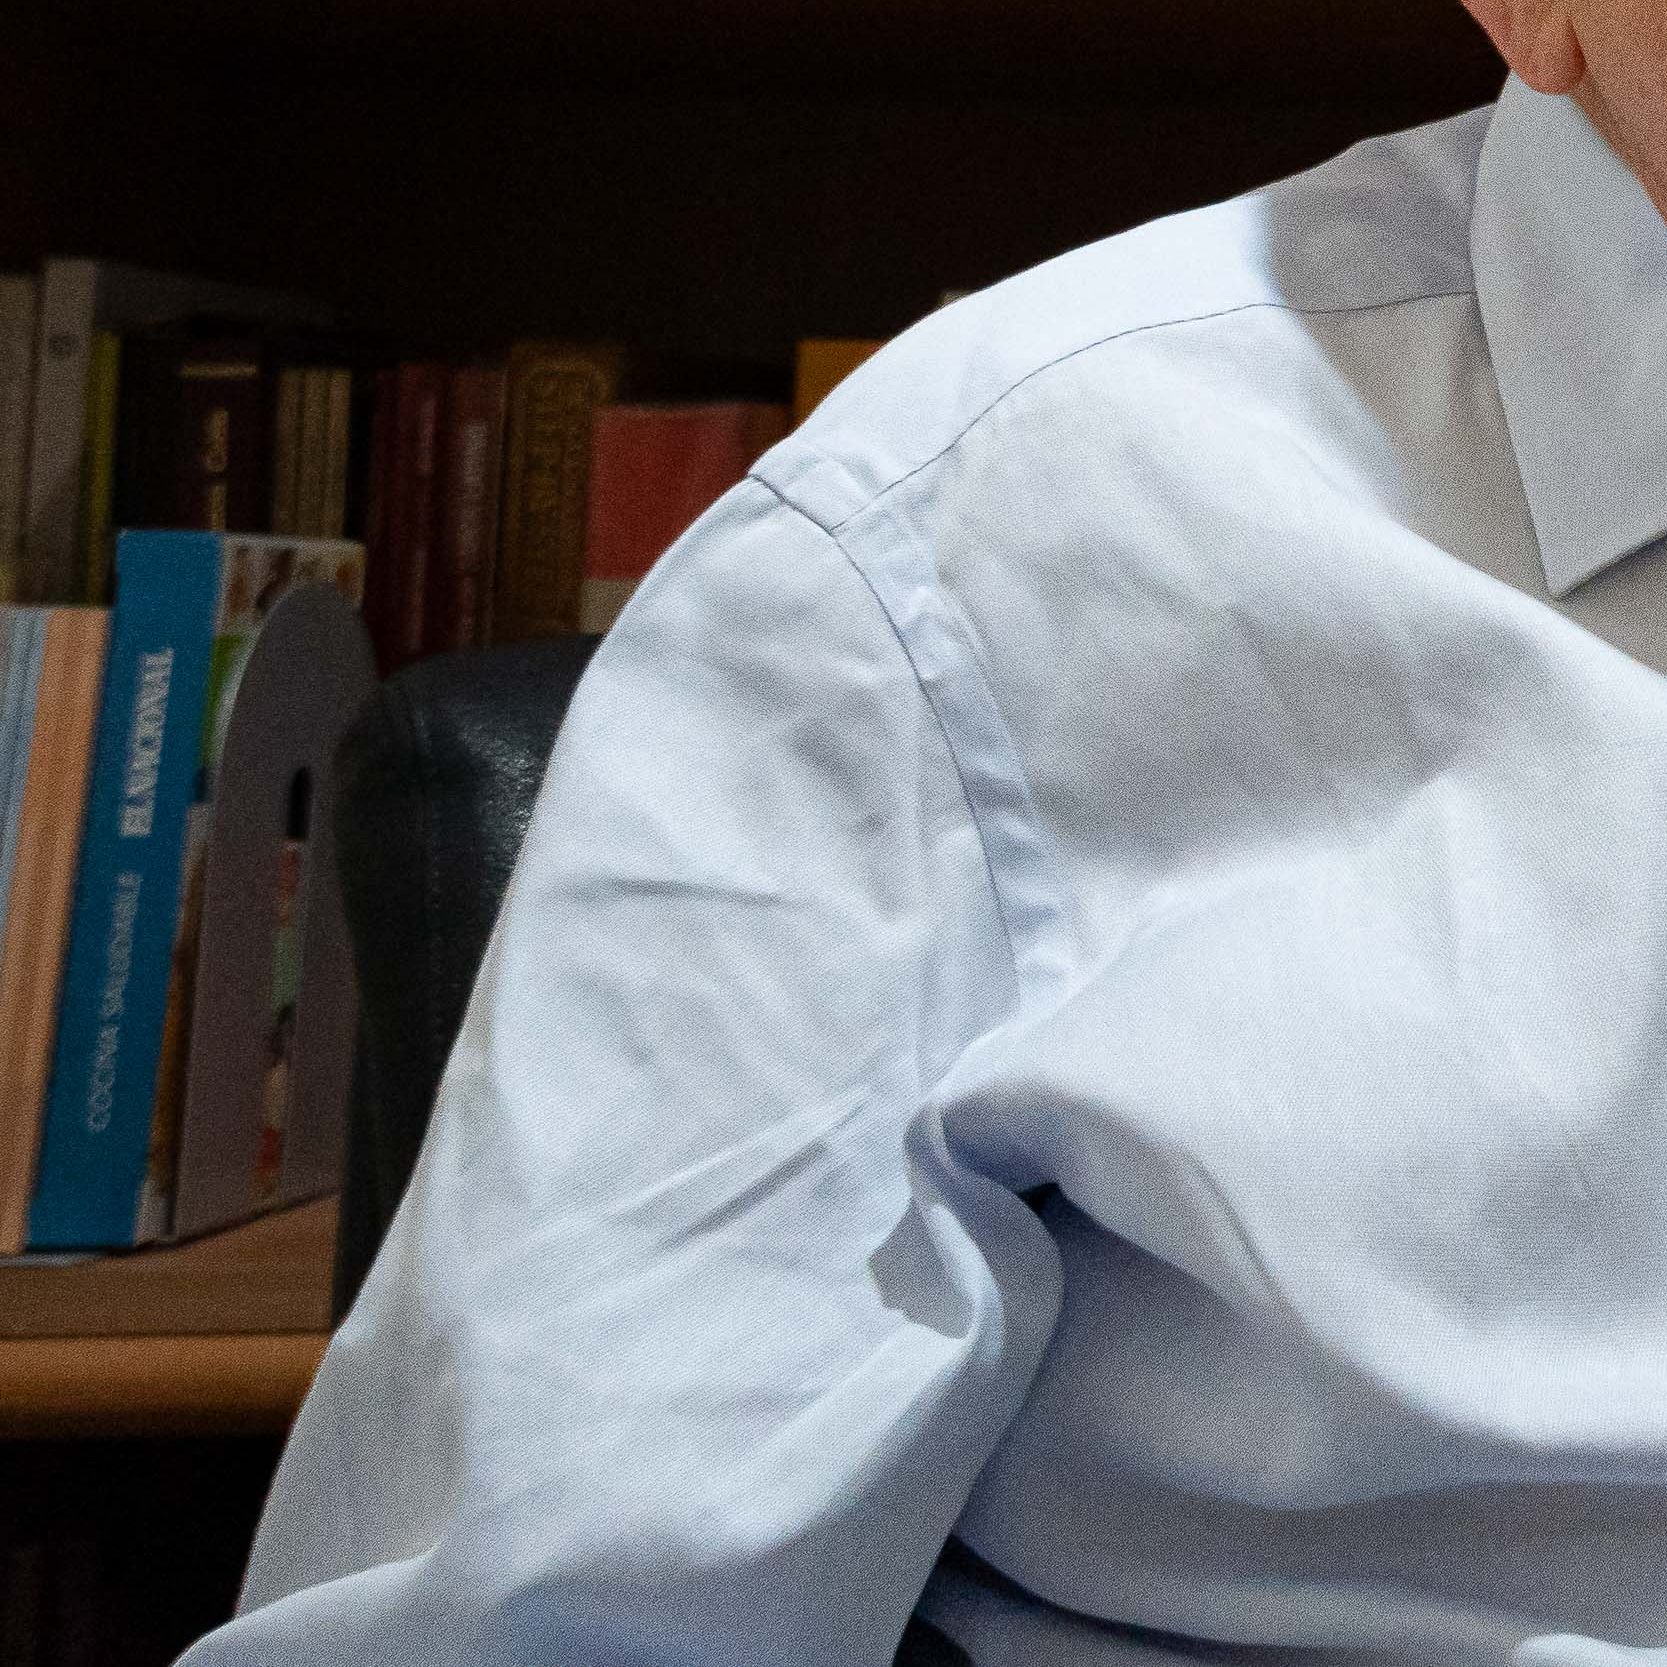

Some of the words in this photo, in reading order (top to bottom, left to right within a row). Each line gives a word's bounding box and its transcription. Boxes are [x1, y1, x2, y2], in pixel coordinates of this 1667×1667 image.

[123, 648, 175, 799] NACIONAL
[120, 799, 153, 837] EL
[86, 1025, 120, 1132] COCINA
